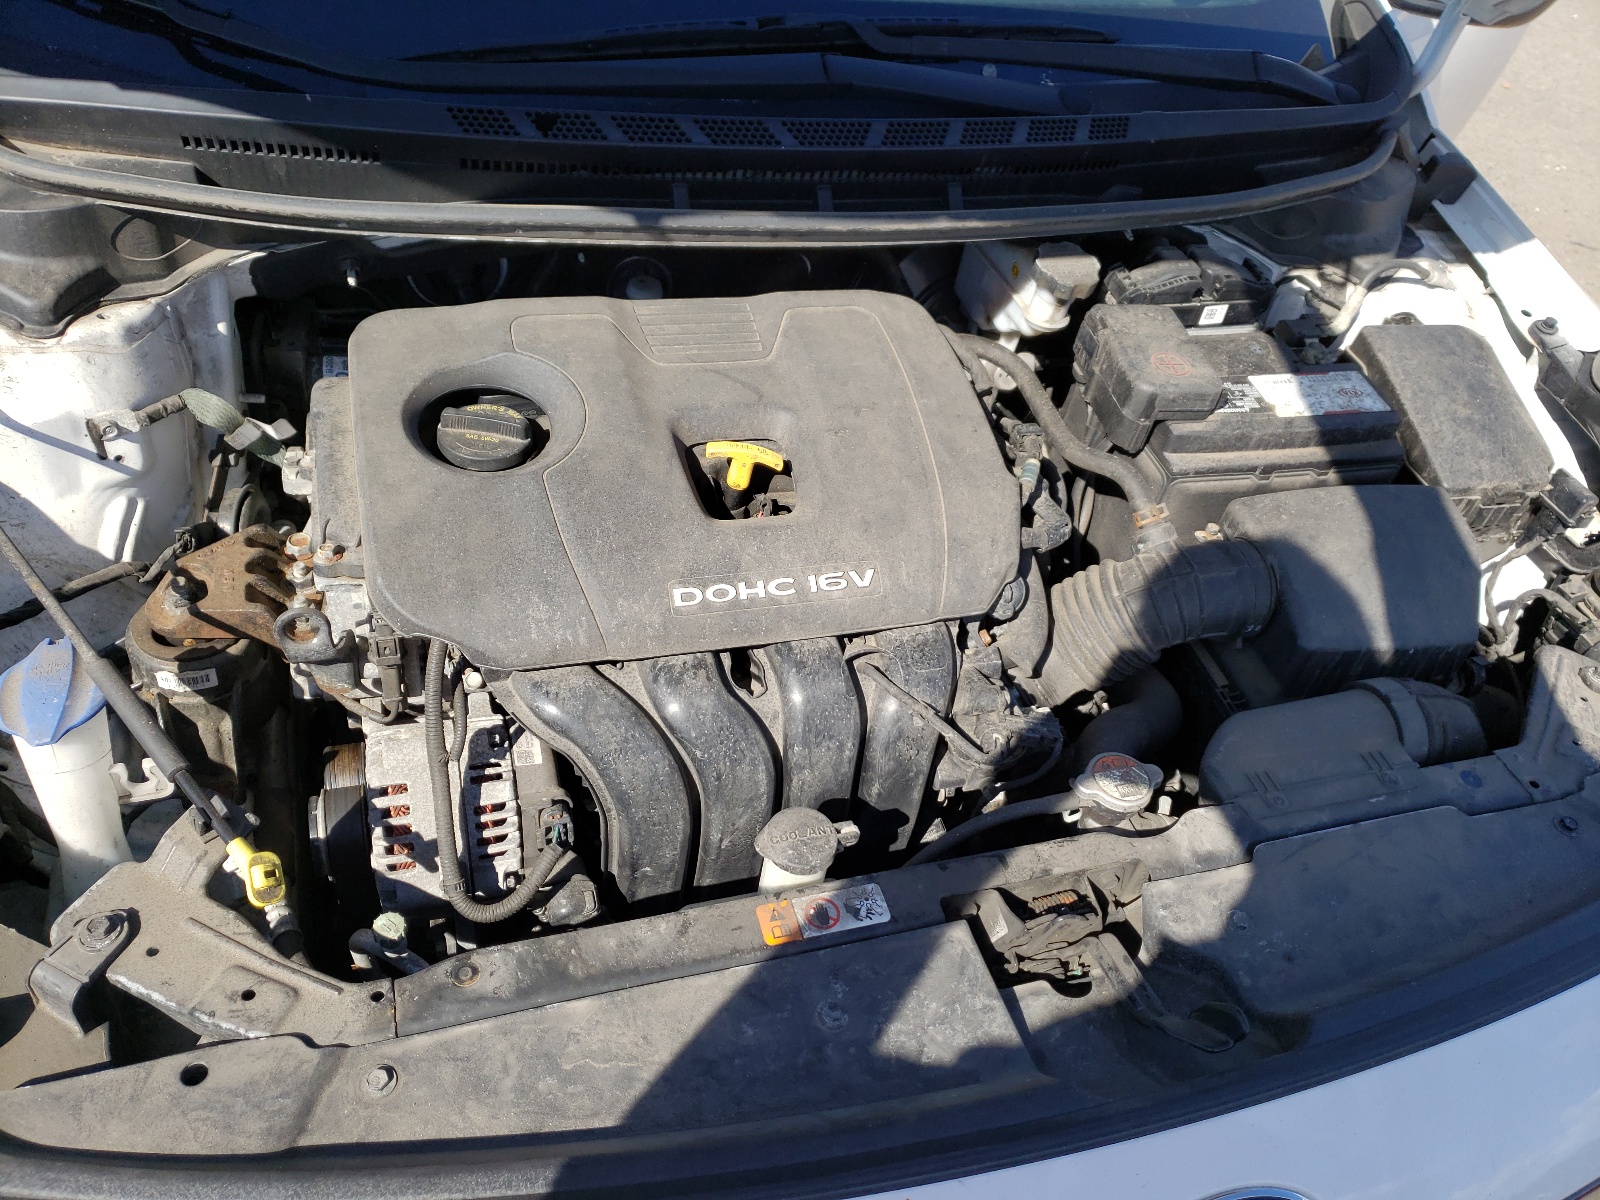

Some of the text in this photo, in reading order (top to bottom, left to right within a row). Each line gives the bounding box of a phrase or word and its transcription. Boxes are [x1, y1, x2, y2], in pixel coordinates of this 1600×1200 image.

[672, 568, 875, 607] DOHC 16V
[770, 825, 834, 845] COOLANT
